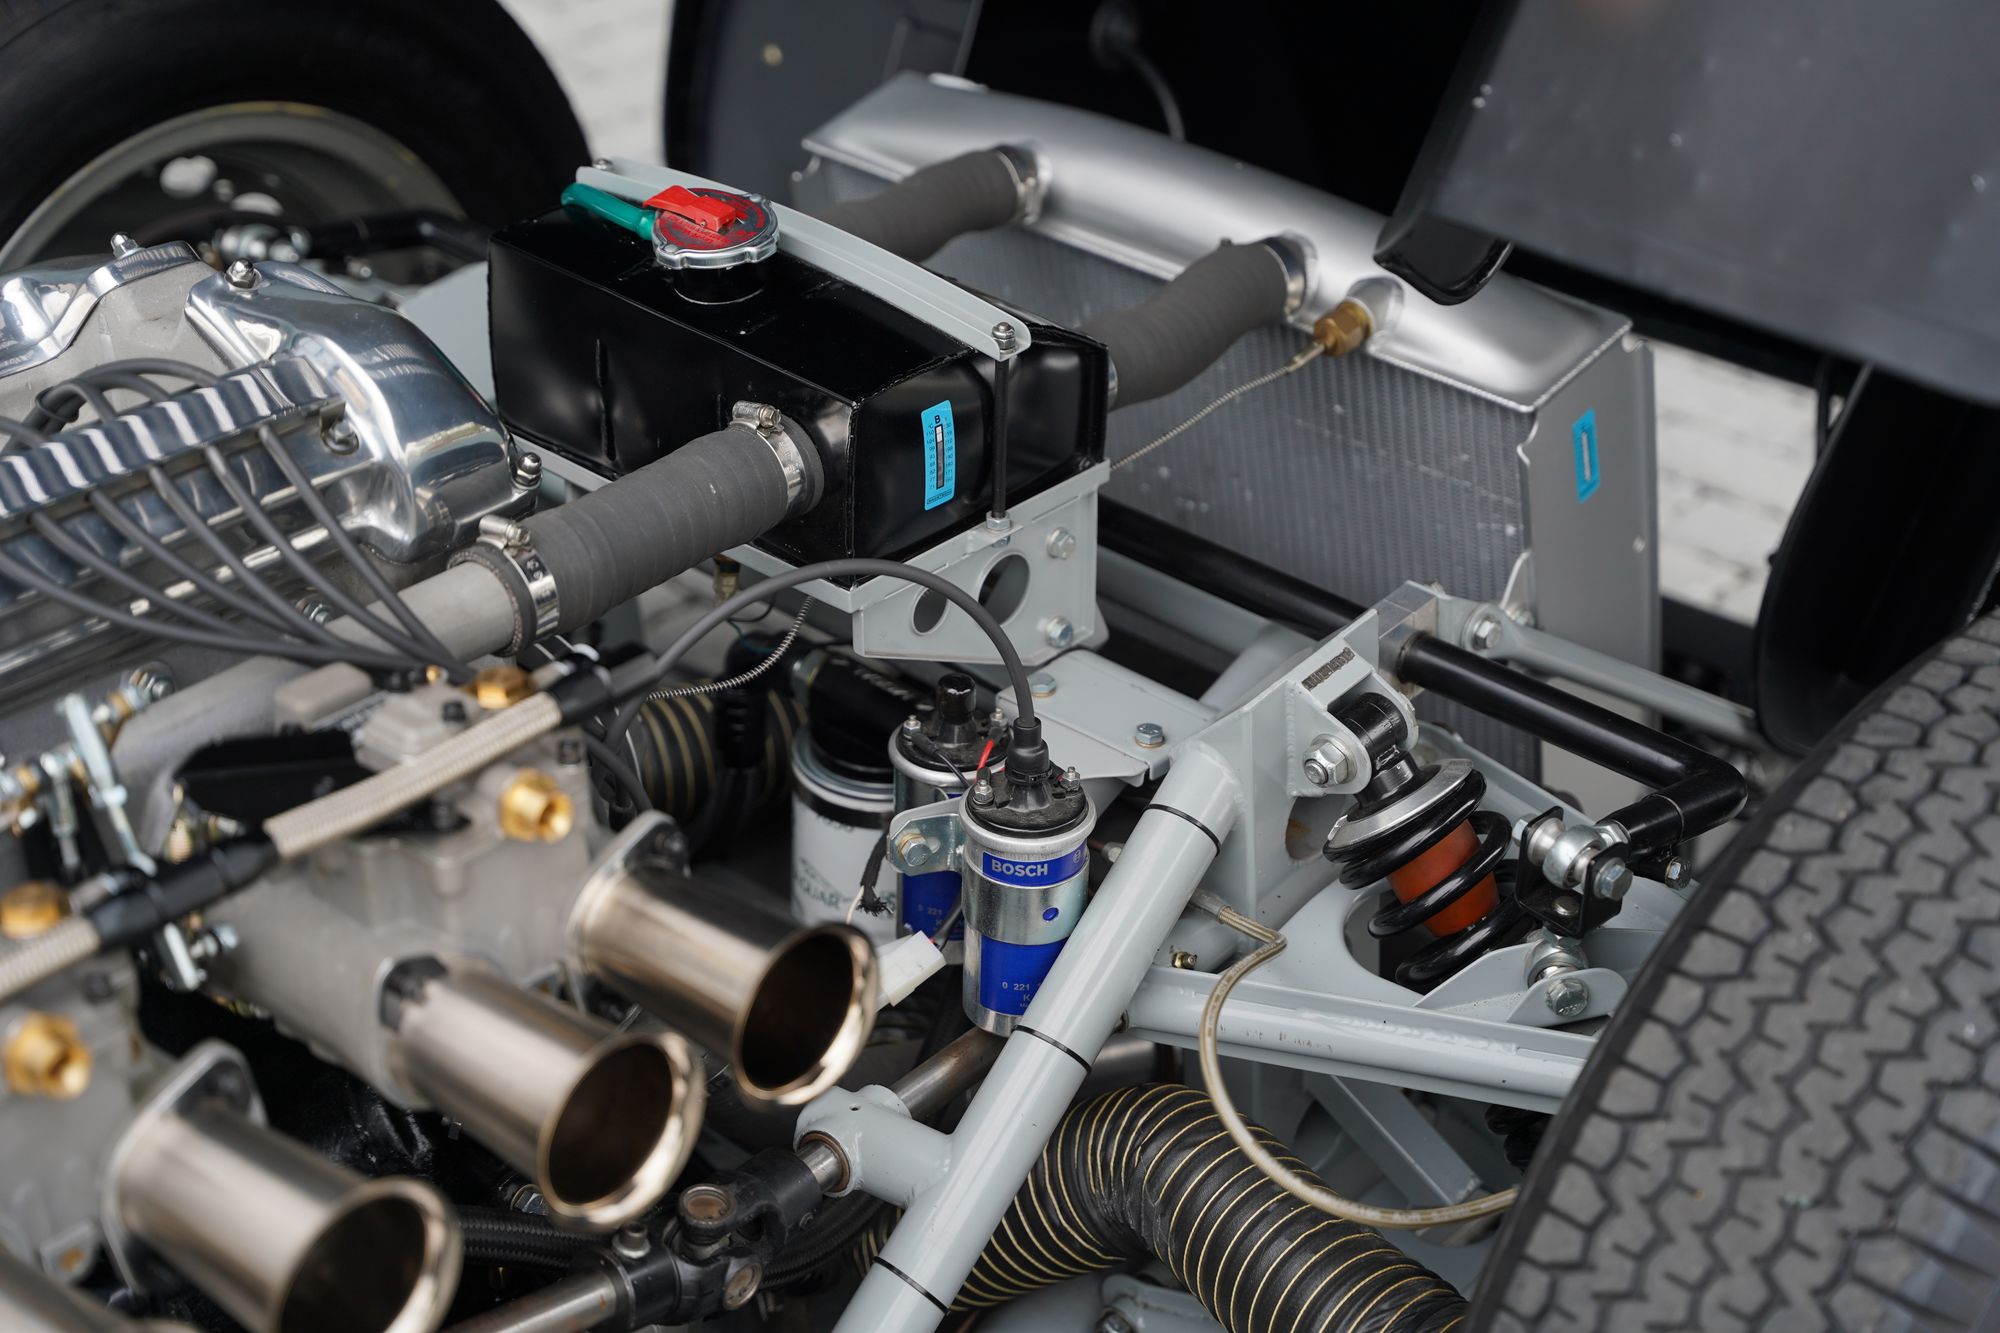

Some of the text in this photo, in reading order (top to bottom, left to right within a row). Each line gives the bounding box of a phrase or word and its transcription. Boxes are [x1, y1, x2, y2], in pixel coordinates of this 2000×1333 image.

[934, 414, 940, 424] B
[991, 859, 1048, 878] BOSCH
[1002, 981, 1030, 991] 0 221
